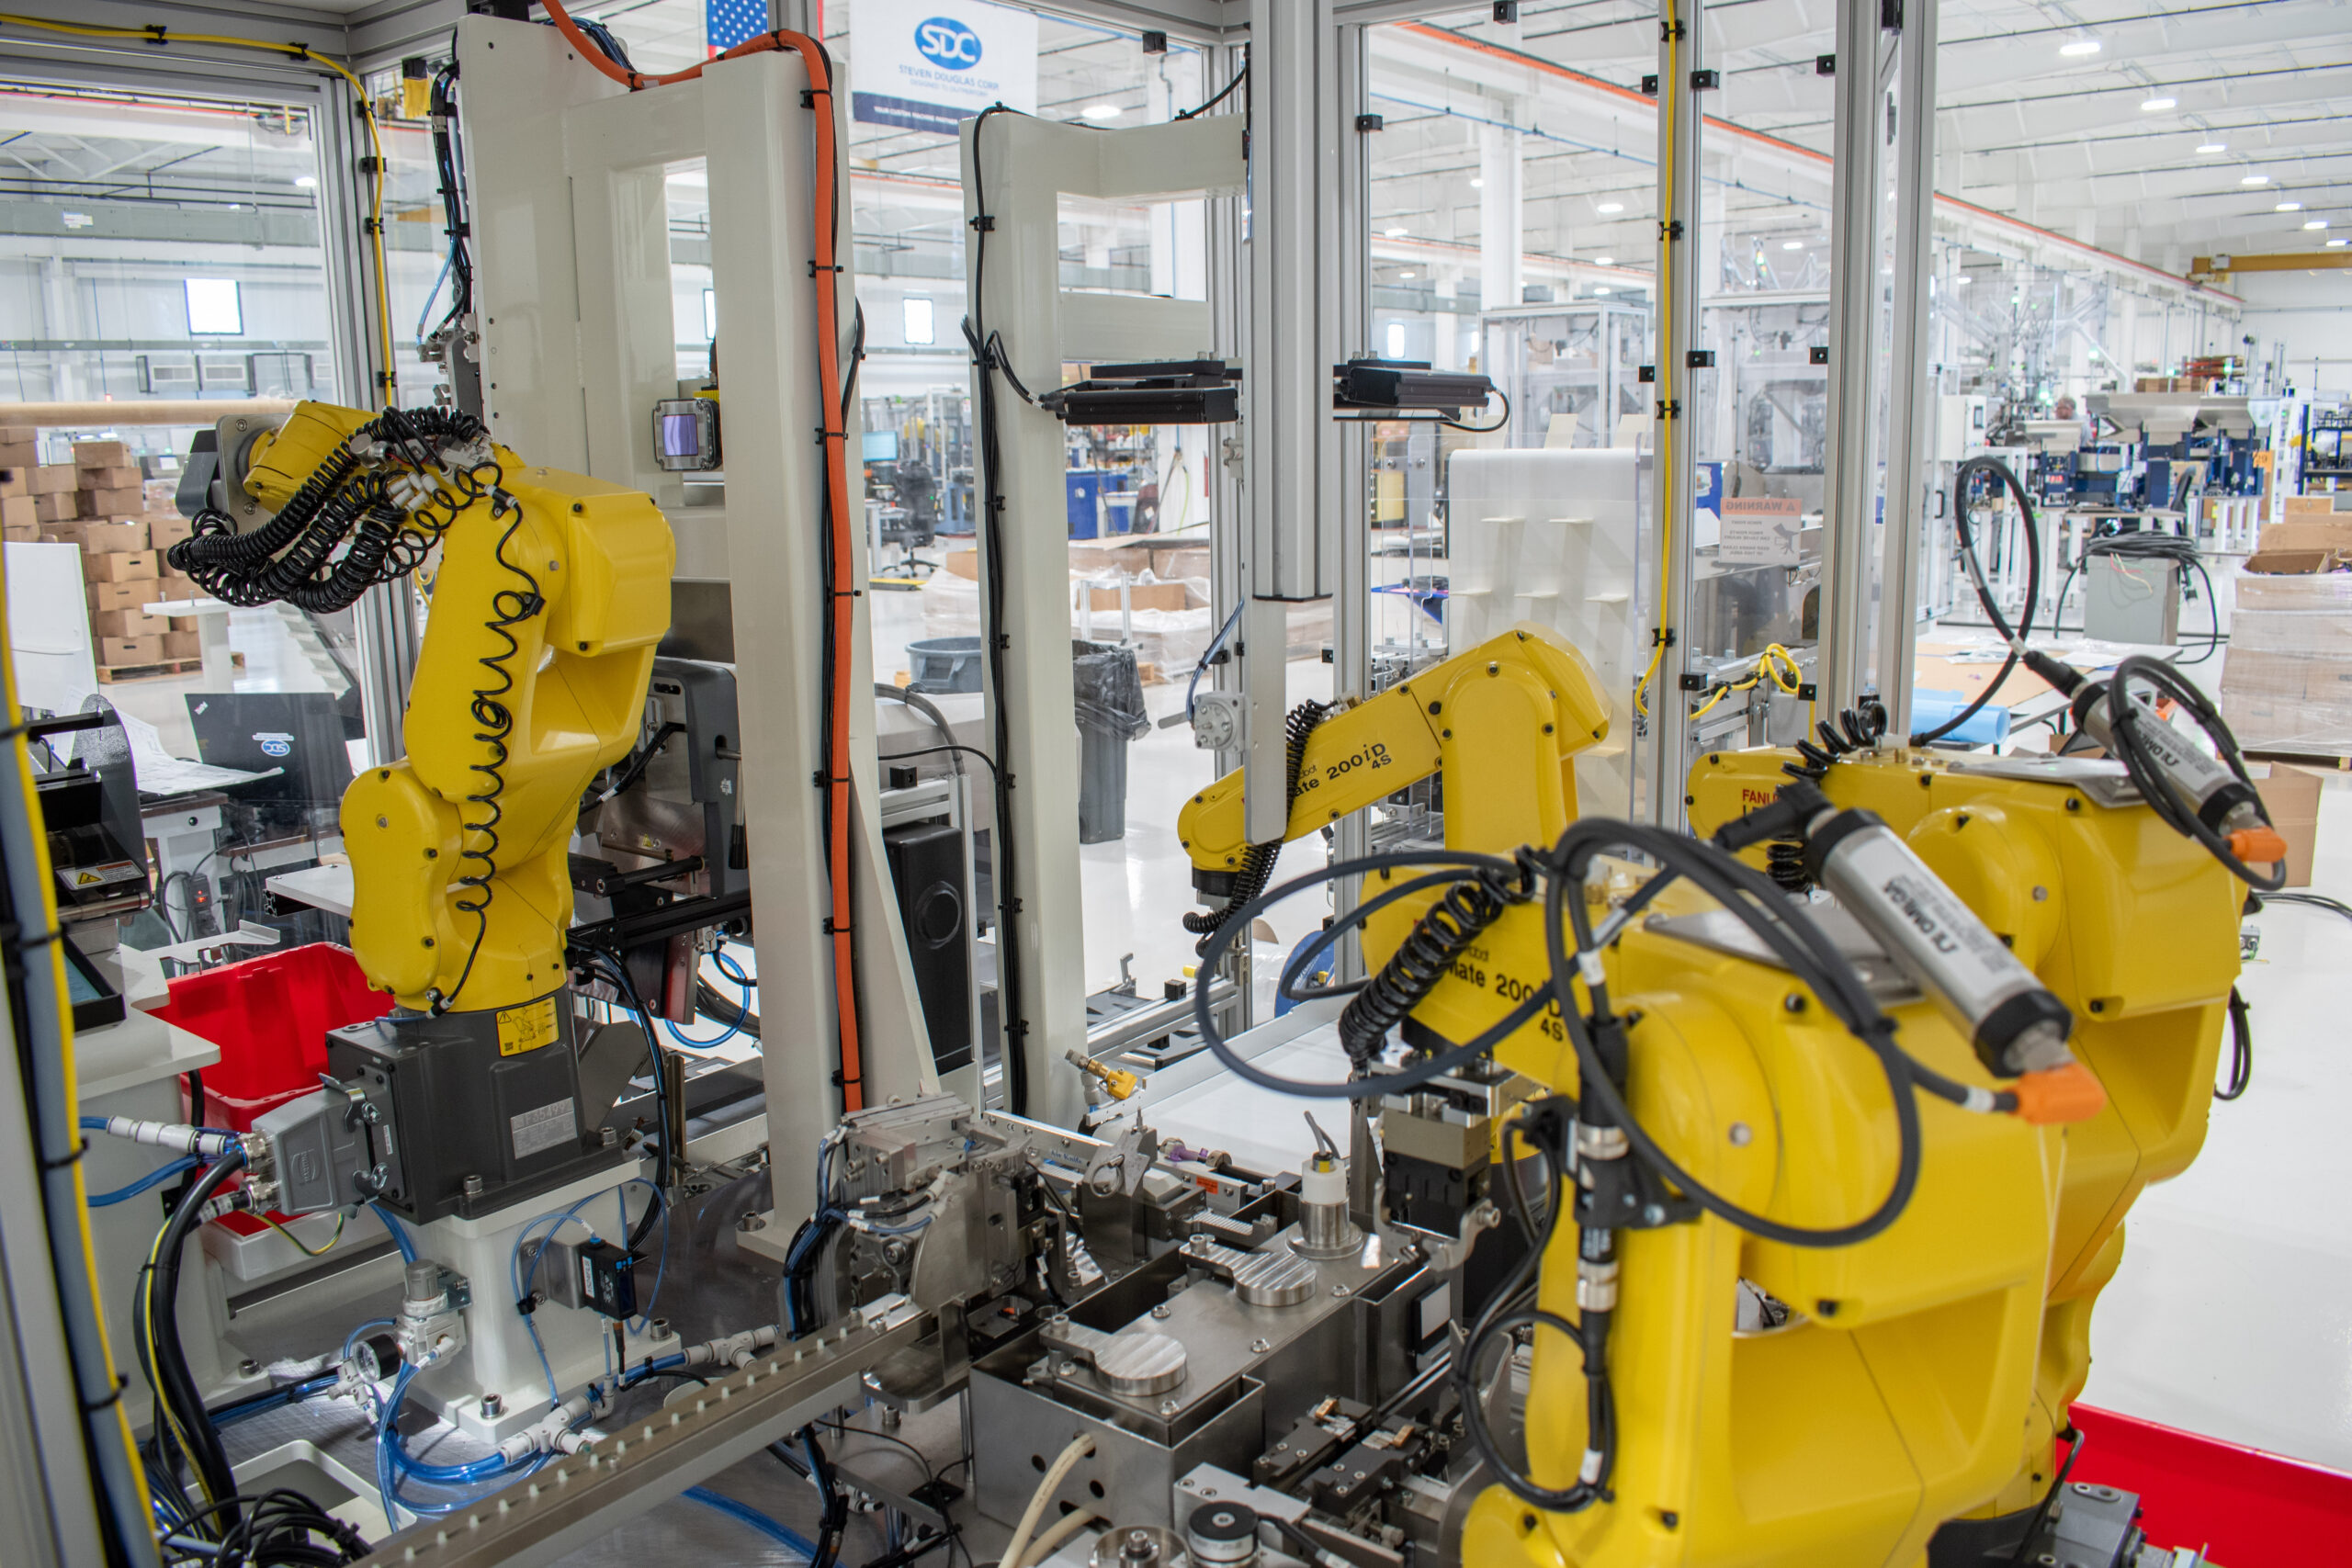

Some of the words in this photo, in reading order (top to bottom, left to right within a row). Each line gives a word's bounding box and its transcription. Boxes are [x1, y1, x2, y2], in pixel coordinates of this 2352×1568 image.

[921, 24, 977, 63] SDC
[899, 63, 933, 79] STEVEN
[933, 72, 976, 86] DOUGLAS
[265, 743, 287, 753] SDC
[1295, 778, 1320, 797] ate
[1326, 743, 1386, 780] 200iD
[1371, 755, 1392, 770] 4S
[1742, 788, 1779, 805] FANU
[1540, 1018, 1563, 1042] 4S
